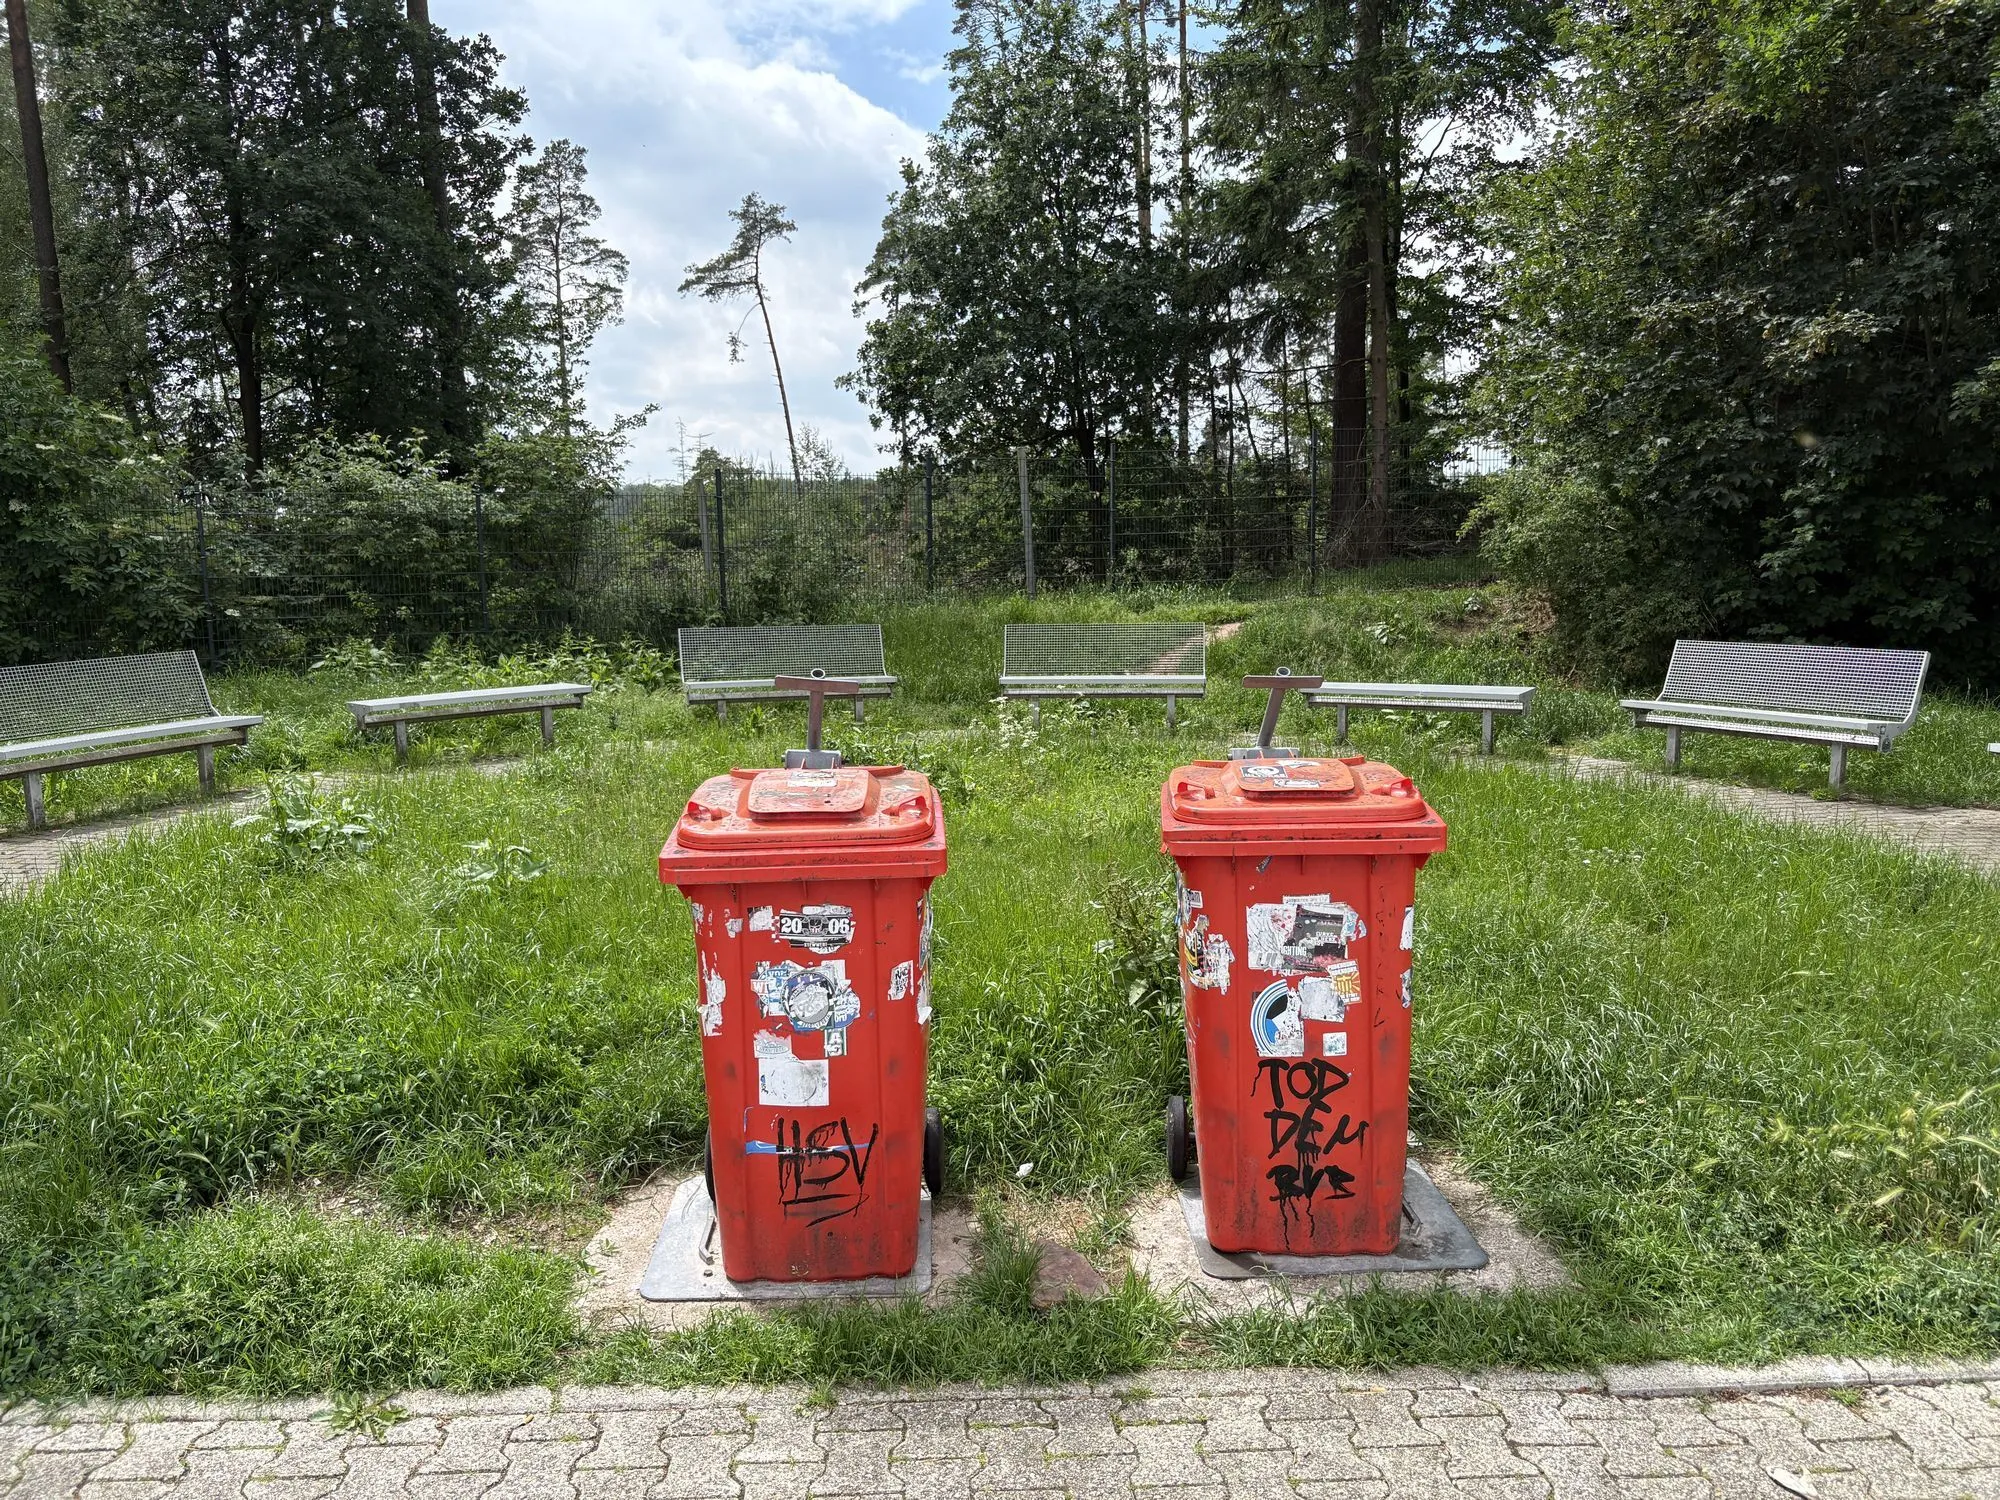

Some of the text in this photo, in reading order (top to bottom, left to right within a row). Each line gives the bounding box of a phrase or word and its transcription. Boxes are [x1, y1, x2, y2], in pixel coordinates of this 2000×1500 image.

[780, 918, 851, 934] 20 06
[1257, 1057, 1350, 1109] TOD
[777, 1117, 879, 1190] HSV
[1263, 1099, 1370, 1159] DEM
